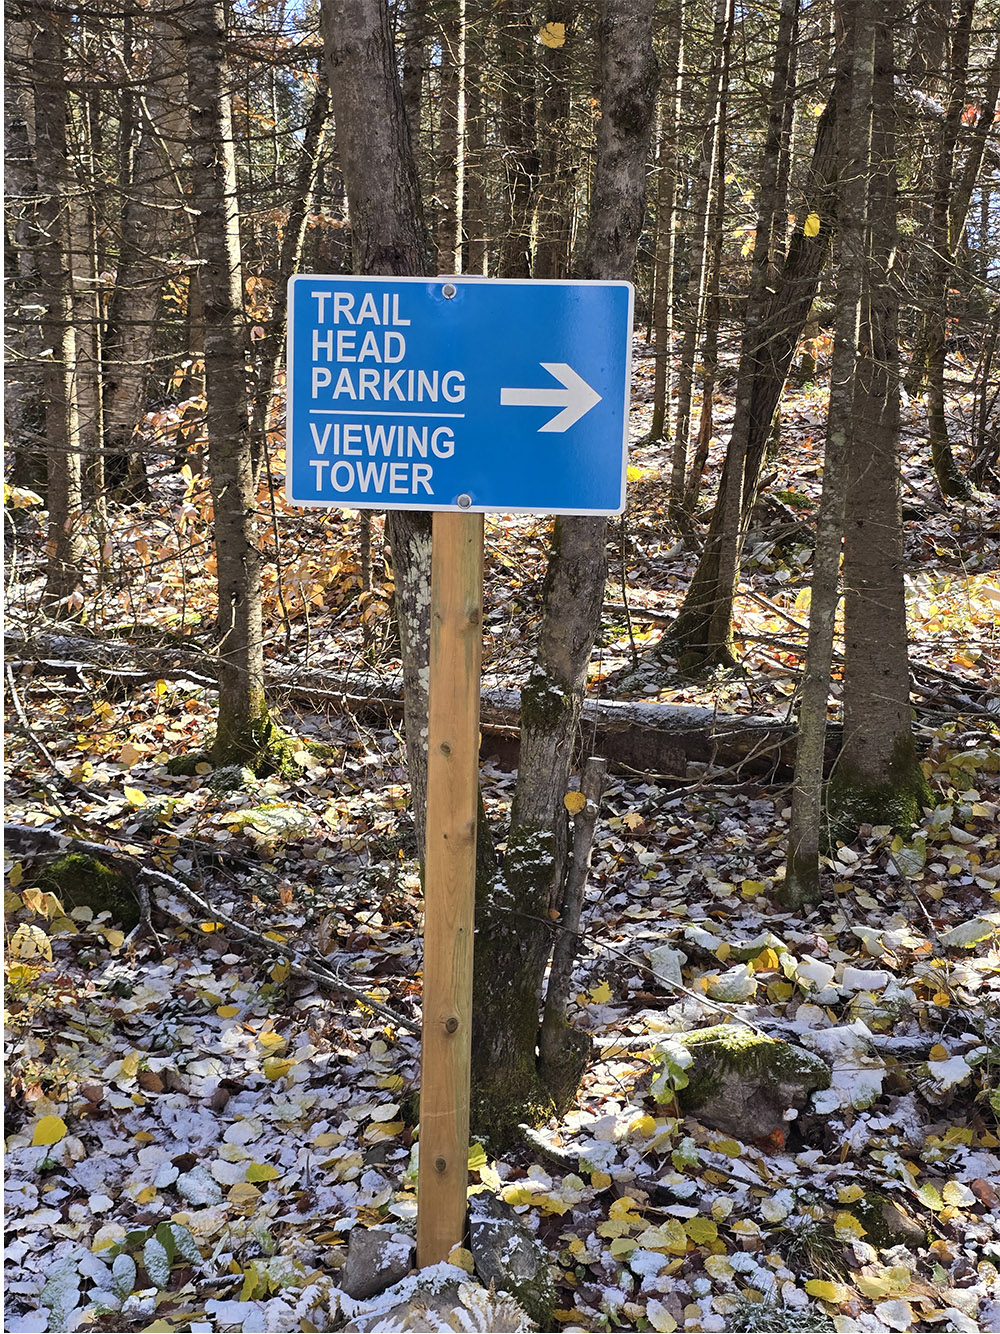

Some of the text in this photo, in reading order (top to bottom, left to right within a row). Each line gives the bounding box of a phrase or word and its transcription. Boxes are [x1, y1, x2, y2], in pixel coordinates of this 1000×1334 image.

[311, 292, 411, 326] TRAIL
[312, 330, 406, 363] HEAD
[312, 367, 465, 403] PARKING
[310, 423, 455, 459] VIEWING
[309, 460, 434, 494] TOWER
